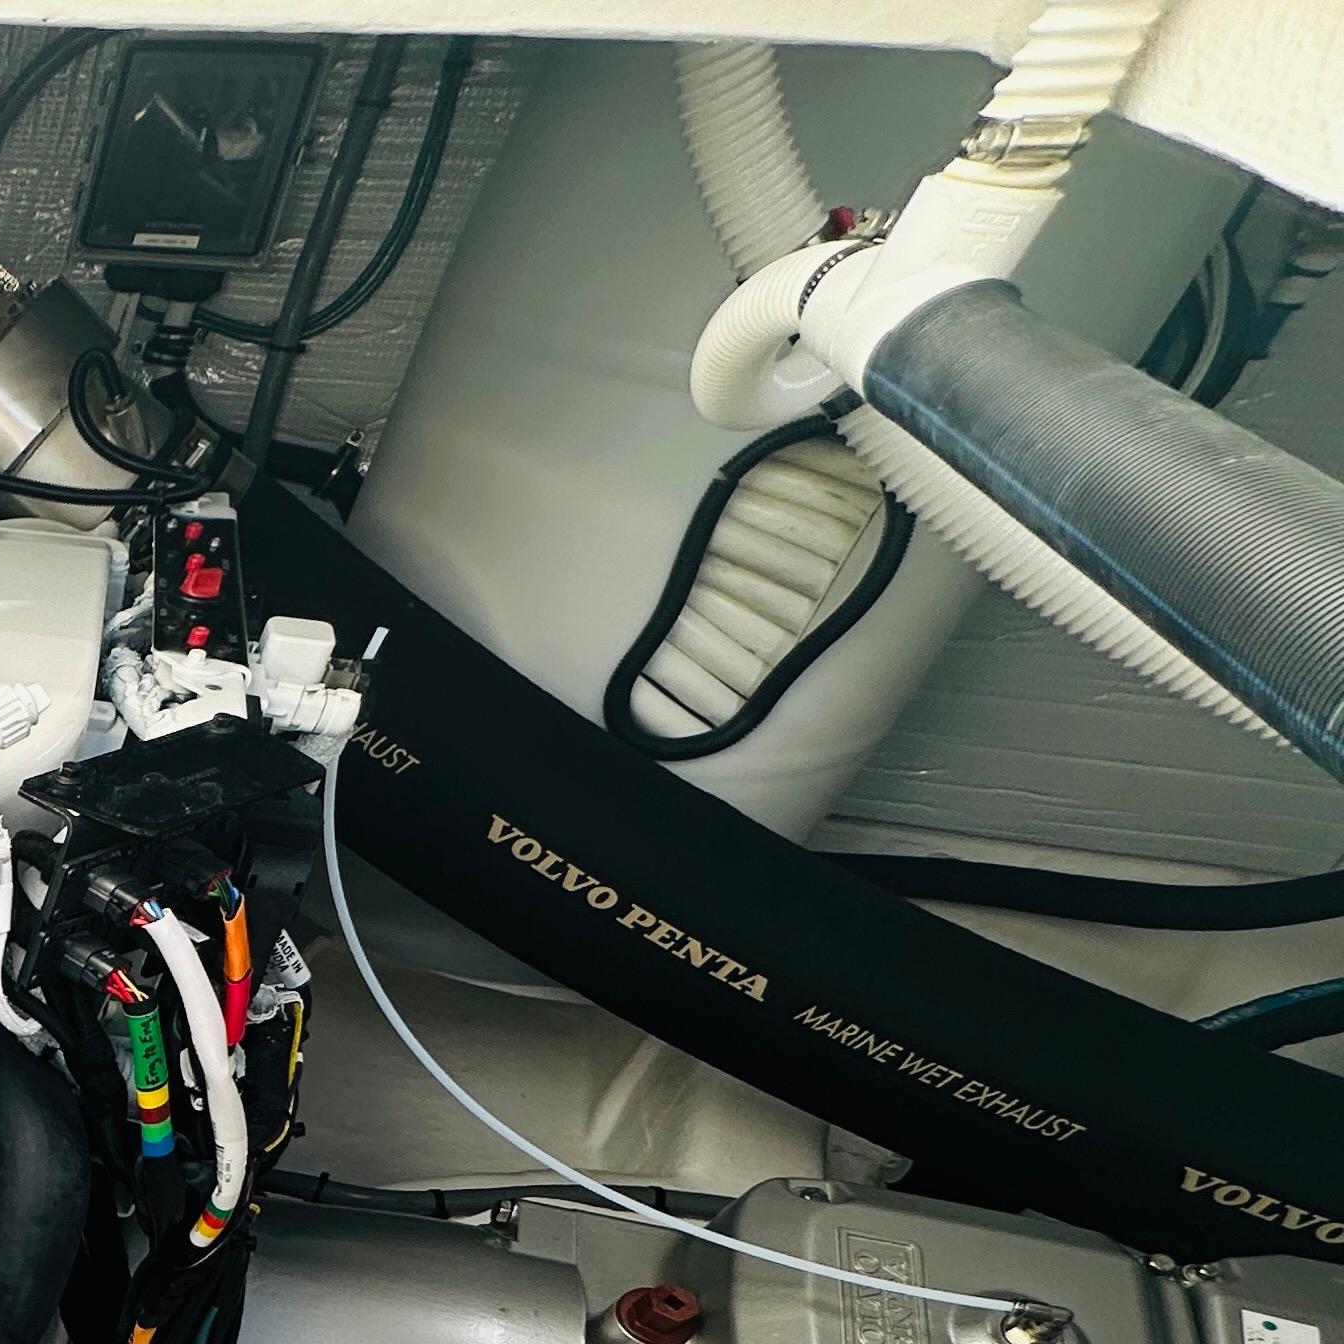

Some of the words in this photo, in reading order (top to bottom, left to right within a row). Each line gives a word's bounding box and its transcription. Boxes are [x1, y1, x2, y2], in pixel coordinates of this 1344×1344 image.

[275, 934, 295, 961] MADE
[291, 959, 304, 974] IN
[487, 813, 618, 909] VOLVO
[616, 903, 769, 1002] PENTA
[793, 1005, 904, 1063] MARINE
[897, 1052, 964, 1089] WET
[953, 1080, 1088, 1142] EXHAUST
[1180, 1166, 1344, 1244] VOLVO
